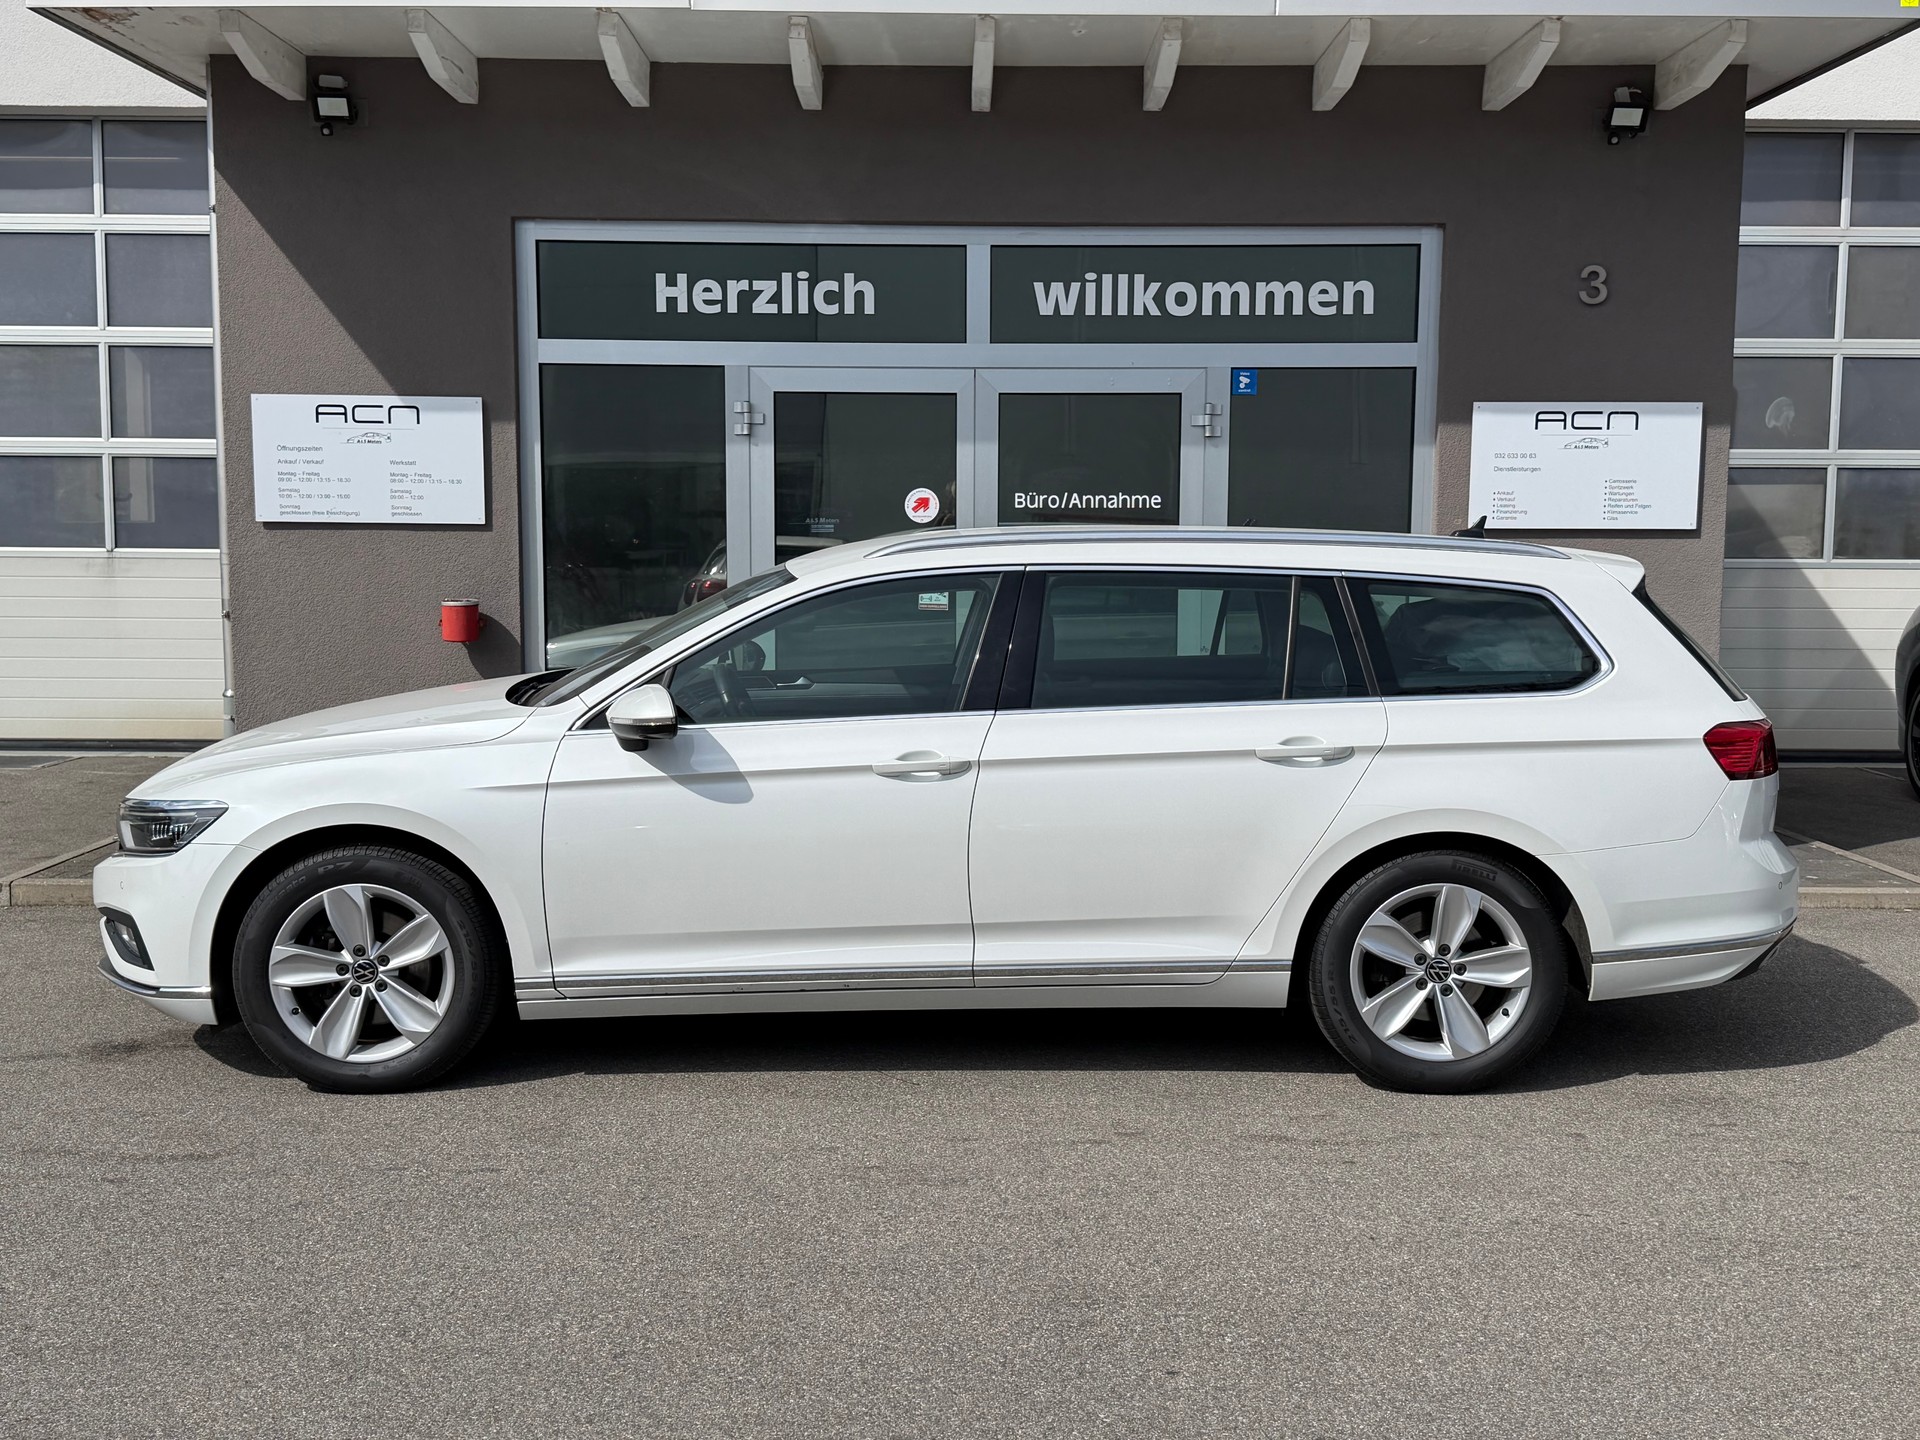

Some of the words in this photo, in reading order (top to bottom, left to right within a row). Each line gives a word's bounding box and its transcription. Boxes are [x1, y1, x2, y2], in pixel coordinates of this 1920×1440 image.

[655, 271, 875, 315] Herzlich
[1033, 272, 1375, 316] willkommen
[1579, 265, 1607, 305] 3
[276, 445, 323, 453] Öffnungszeiten
[1014, 492, 1162, 509] Büro/Annahme
